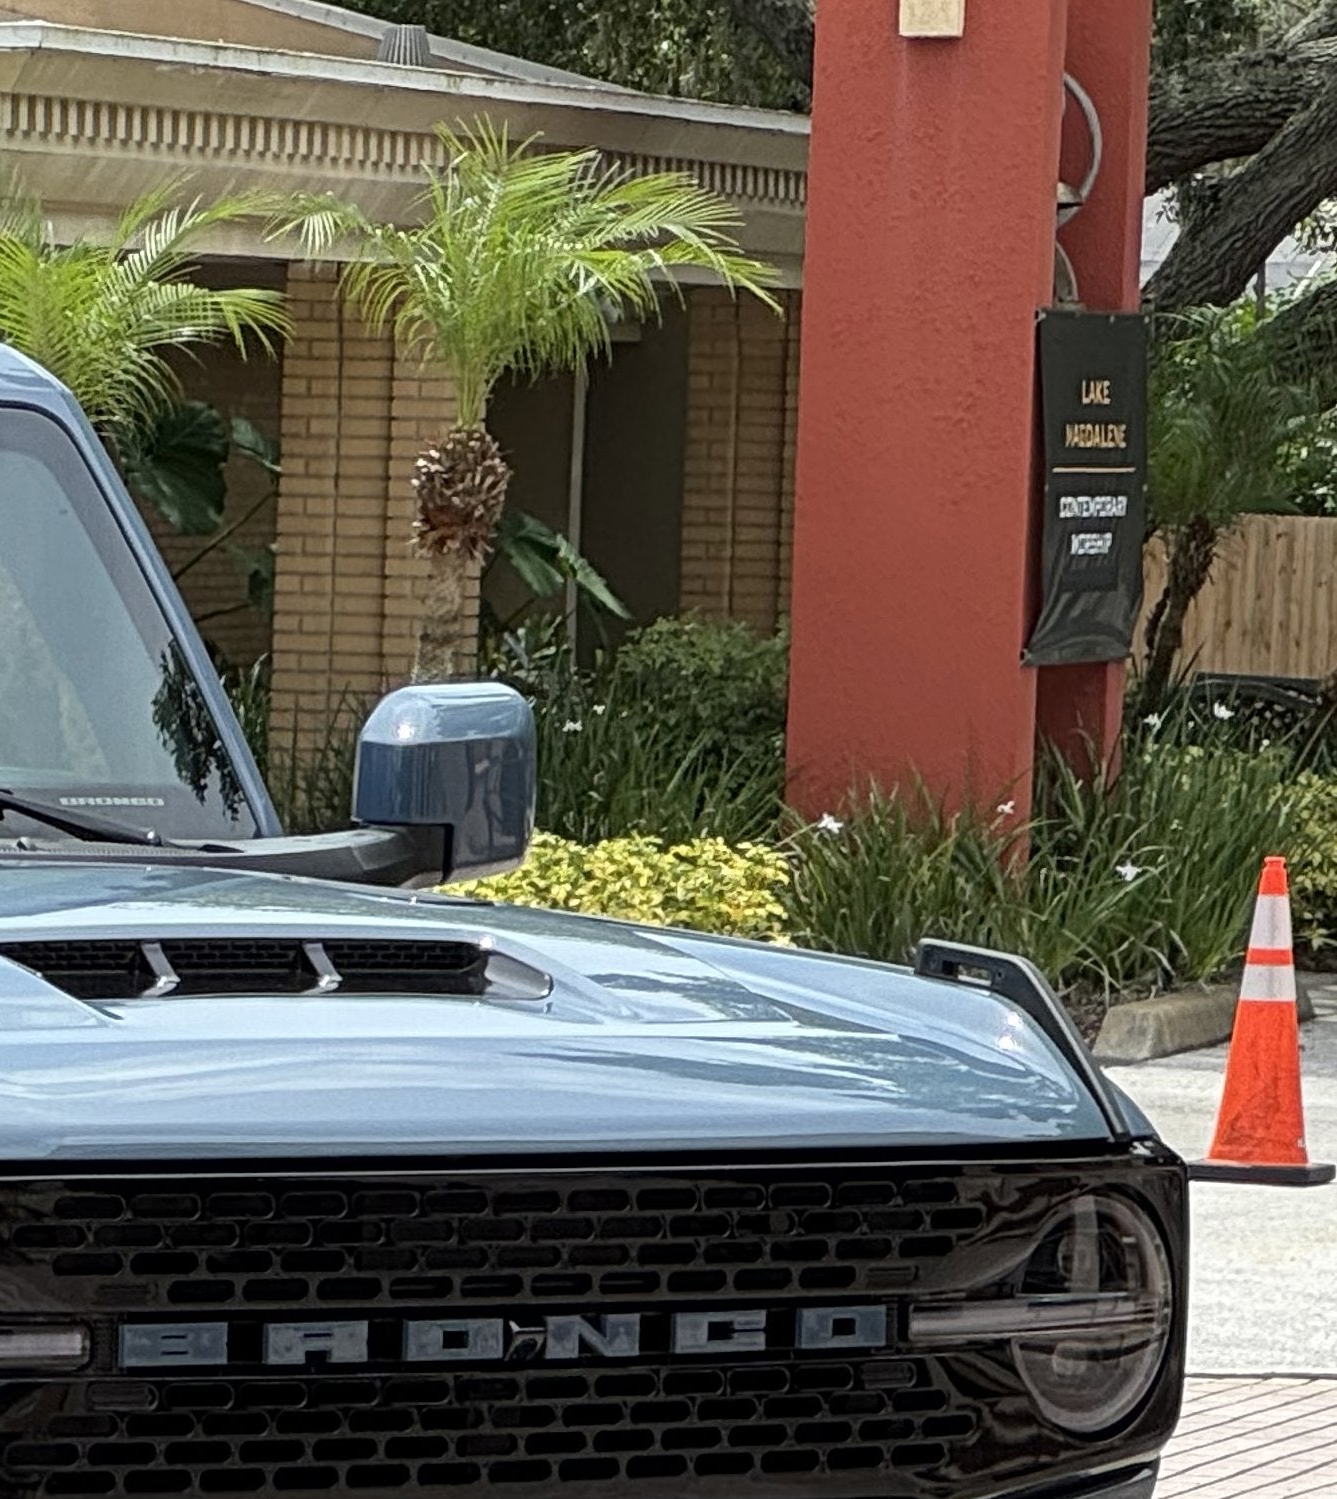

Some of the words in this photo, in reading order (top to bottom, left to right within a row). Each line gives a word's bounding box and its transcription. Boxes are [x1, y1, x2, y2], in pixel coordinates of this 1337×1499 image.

[1082, 379, 1111, 405] LAKE
[59, 797, 165, 806] BRONCO
[118, 1305, 887, 1367] BRONCO
